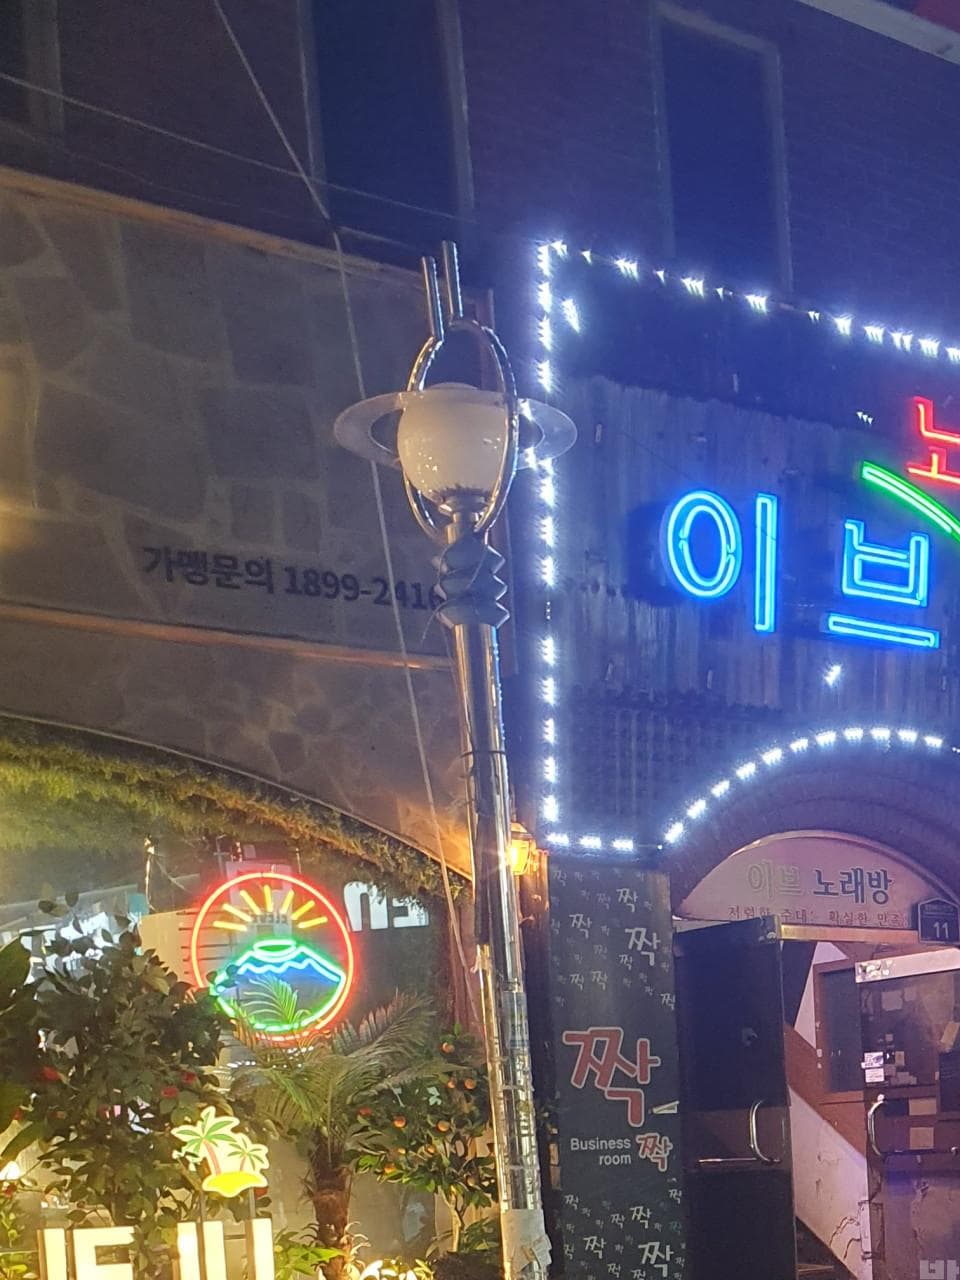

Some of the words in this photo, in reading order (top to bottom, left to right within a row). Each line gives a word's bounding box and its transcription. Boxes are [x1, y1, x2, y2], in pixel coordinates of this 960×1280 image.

[143, 546, 275, 594] 가맹문의
[667, 489, 940, 648] 이브
[747, 861, 801, 898] 이브
[812, 865, 893, 906] 노래방
[616, 888, 639, 912] 짝
[569, 913, 593, 939] 짝
[933, 921, 949, 939] 11
[625, 927, 662, 967] 짝
[562, 1026, 662, 1128] 짝
[570, 1136, 631, 1151] Business
[635, 1132, 674, 1172] 짝
[600, 1153, 632, 1166] room
[610, 1213, 626, 1229] 짝
[630, 1205, 652, 1229] 짝
[583, 1235, 607, 1259] 짝
[638, 1241, 674, 1278] 짝
